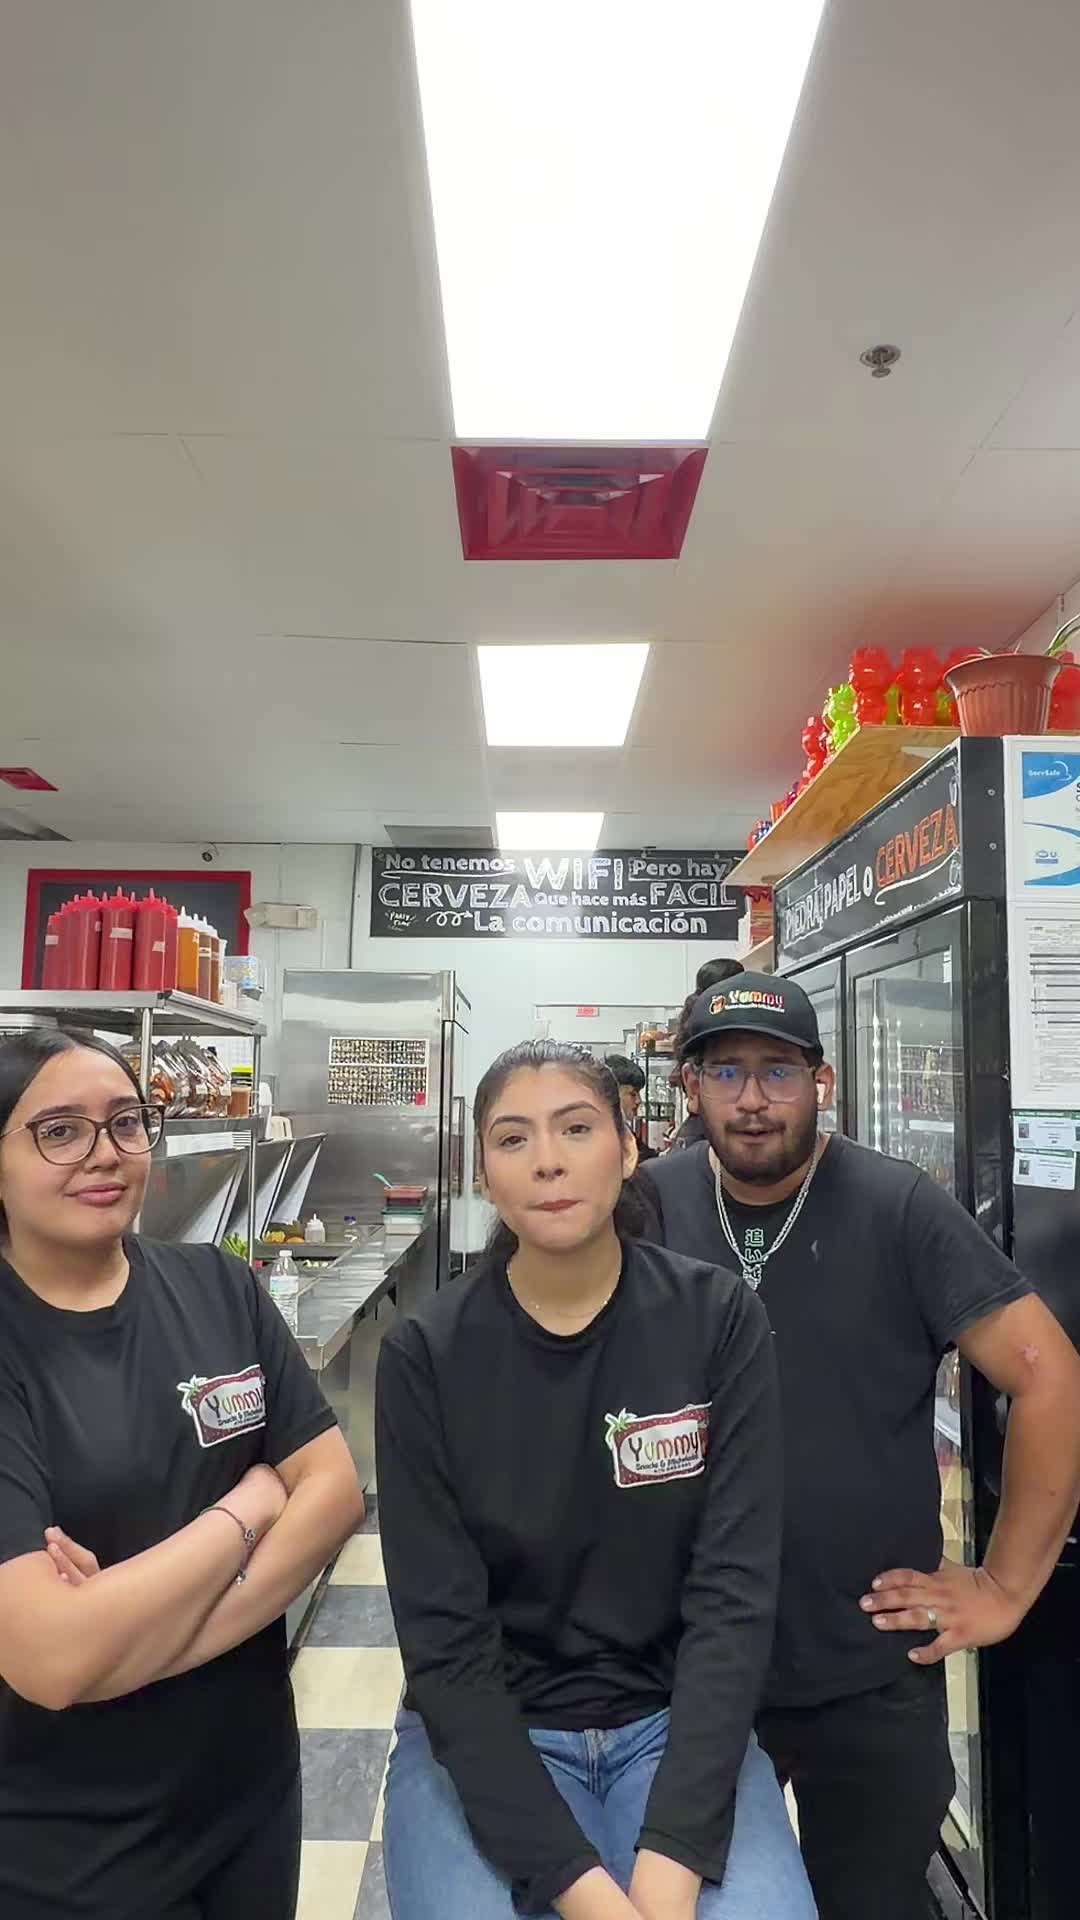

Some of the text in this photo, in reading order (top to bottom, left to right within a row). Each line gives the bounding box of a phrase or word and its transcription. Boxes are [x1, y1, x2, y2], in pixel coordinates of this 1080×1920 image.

[385, 854, 727, 890] No tenemos WIFI Pero hay
[824, 864, 861, 920] PAPEL
[876, 804, 958, 888] CERVEZA
[378, 883, 532, 909] CERVEZA
[571, 891, 609, 906] hace
[613, 893, 648, 906] más
[650, 883, 736, 905] FACIL
[474, 911, 707, 933] La comunicación
[729, 990, 784, 1008] Yummy
[628, 1431, 699, 1461] Yummy
